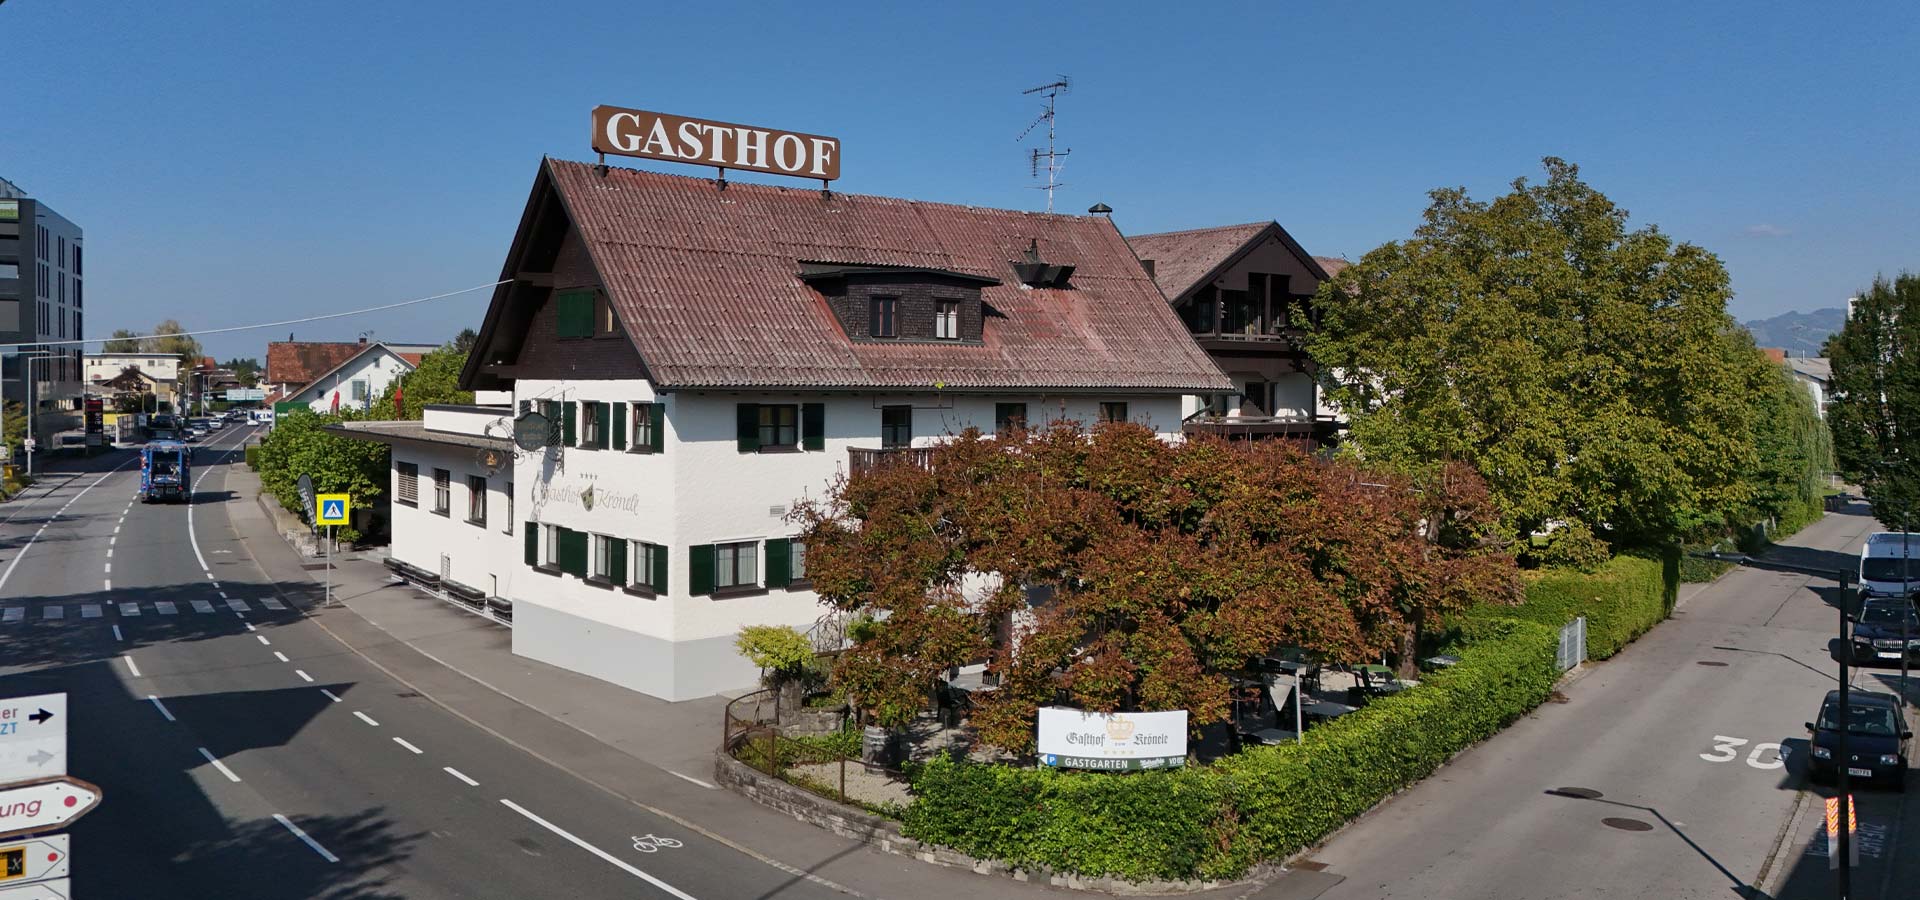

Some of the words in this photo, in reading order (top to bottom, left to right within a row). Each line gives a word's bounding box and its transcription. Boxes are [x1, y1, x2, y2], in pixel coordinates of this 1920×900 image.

[606, 111, 836, 176] GASTHOF
[0, 708, 18, 720] er
[1066, 732, 1106, 747] Gasthof
[1133, 732, 1168, 746] Krönele
[1699, 735, 1792, 769] 30
[1065, 757, 1128, 769] GASTGARTEN
